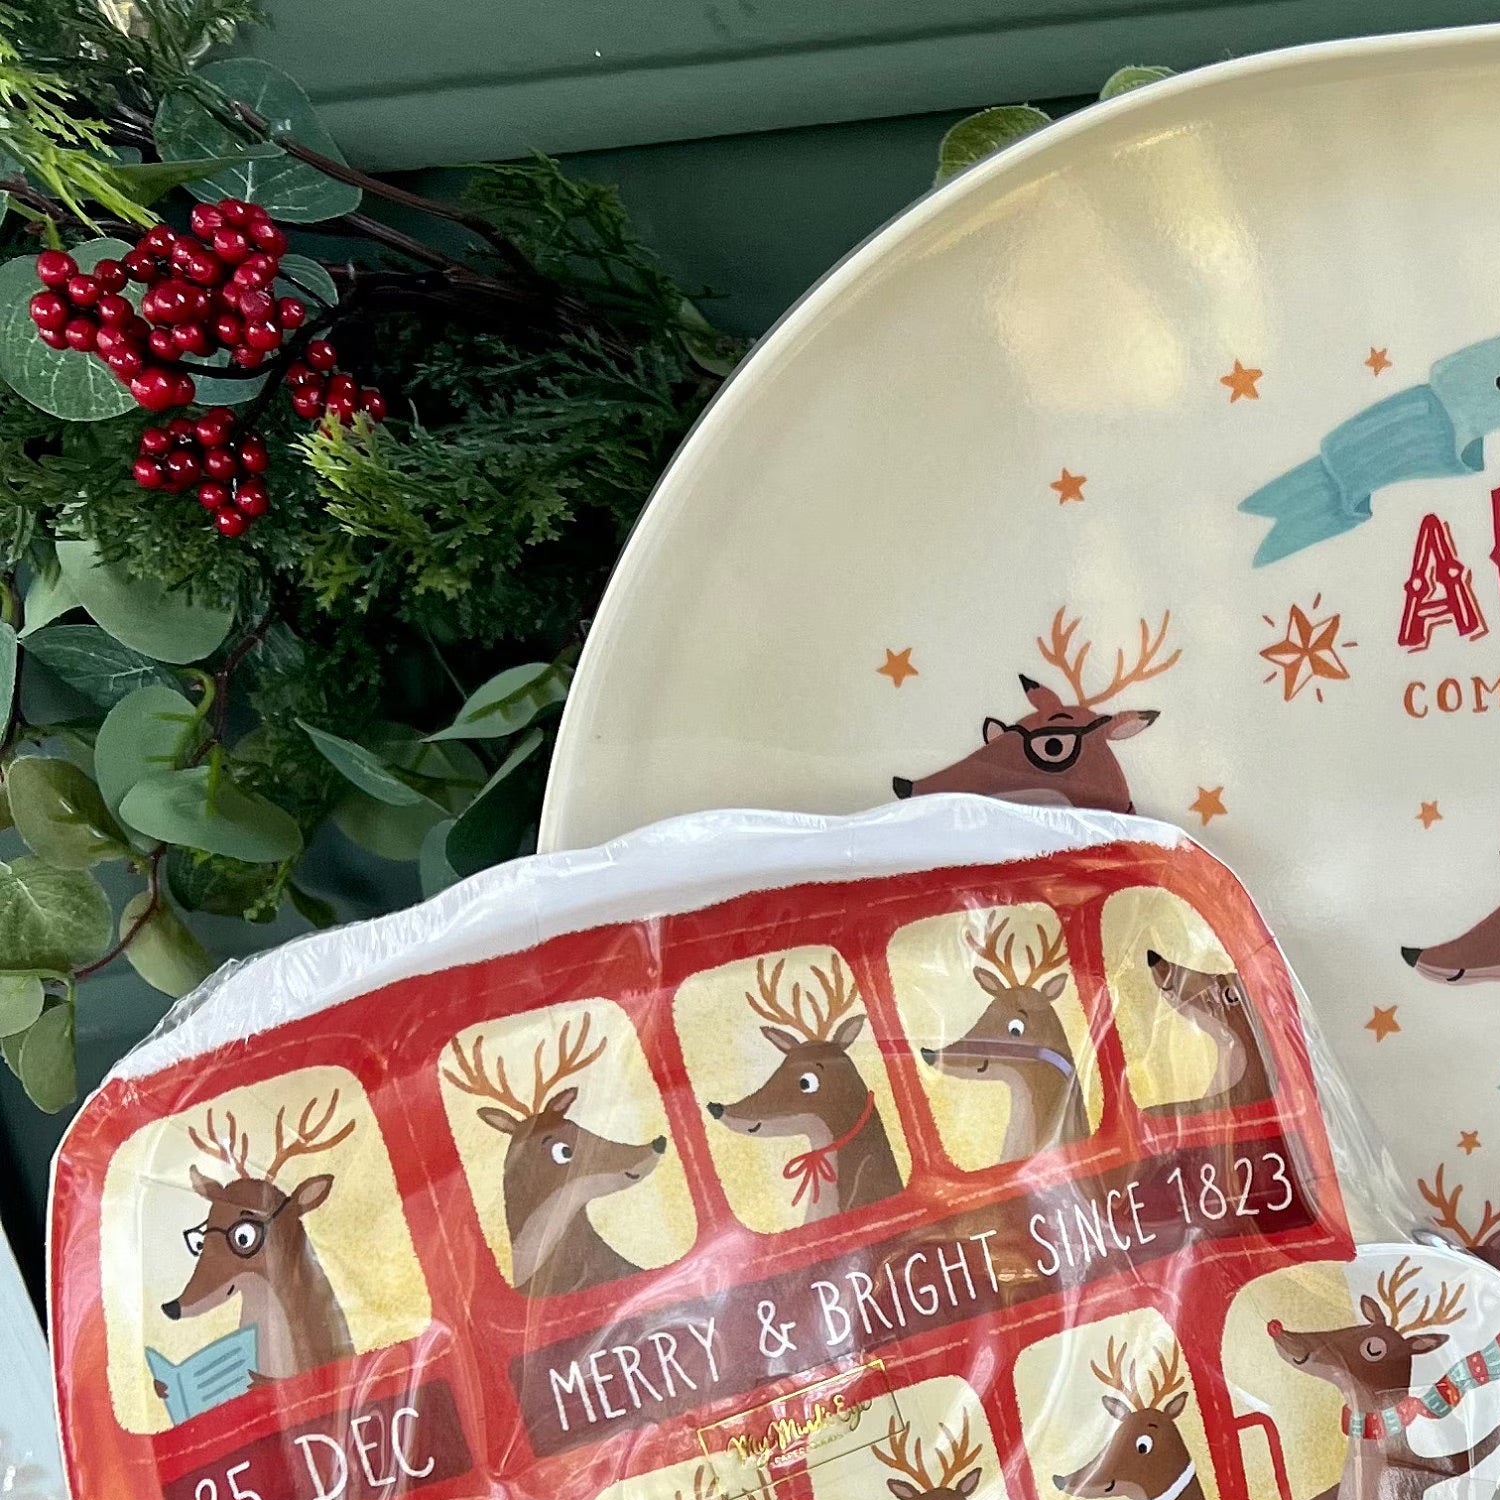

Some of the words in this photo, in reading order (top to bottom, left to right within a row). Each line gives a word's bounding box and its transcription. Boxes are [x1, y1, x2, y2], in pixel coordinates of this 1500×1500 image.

[549, 1317, 723, 1436] MERRY
[756, 1297, 803, 1357] &
[813, 1224, 1005, 1348] BRIGHT
[1030, 1180, 1174, 1279] SINCE
[1167, 1150, 1296, 1233] 1823
